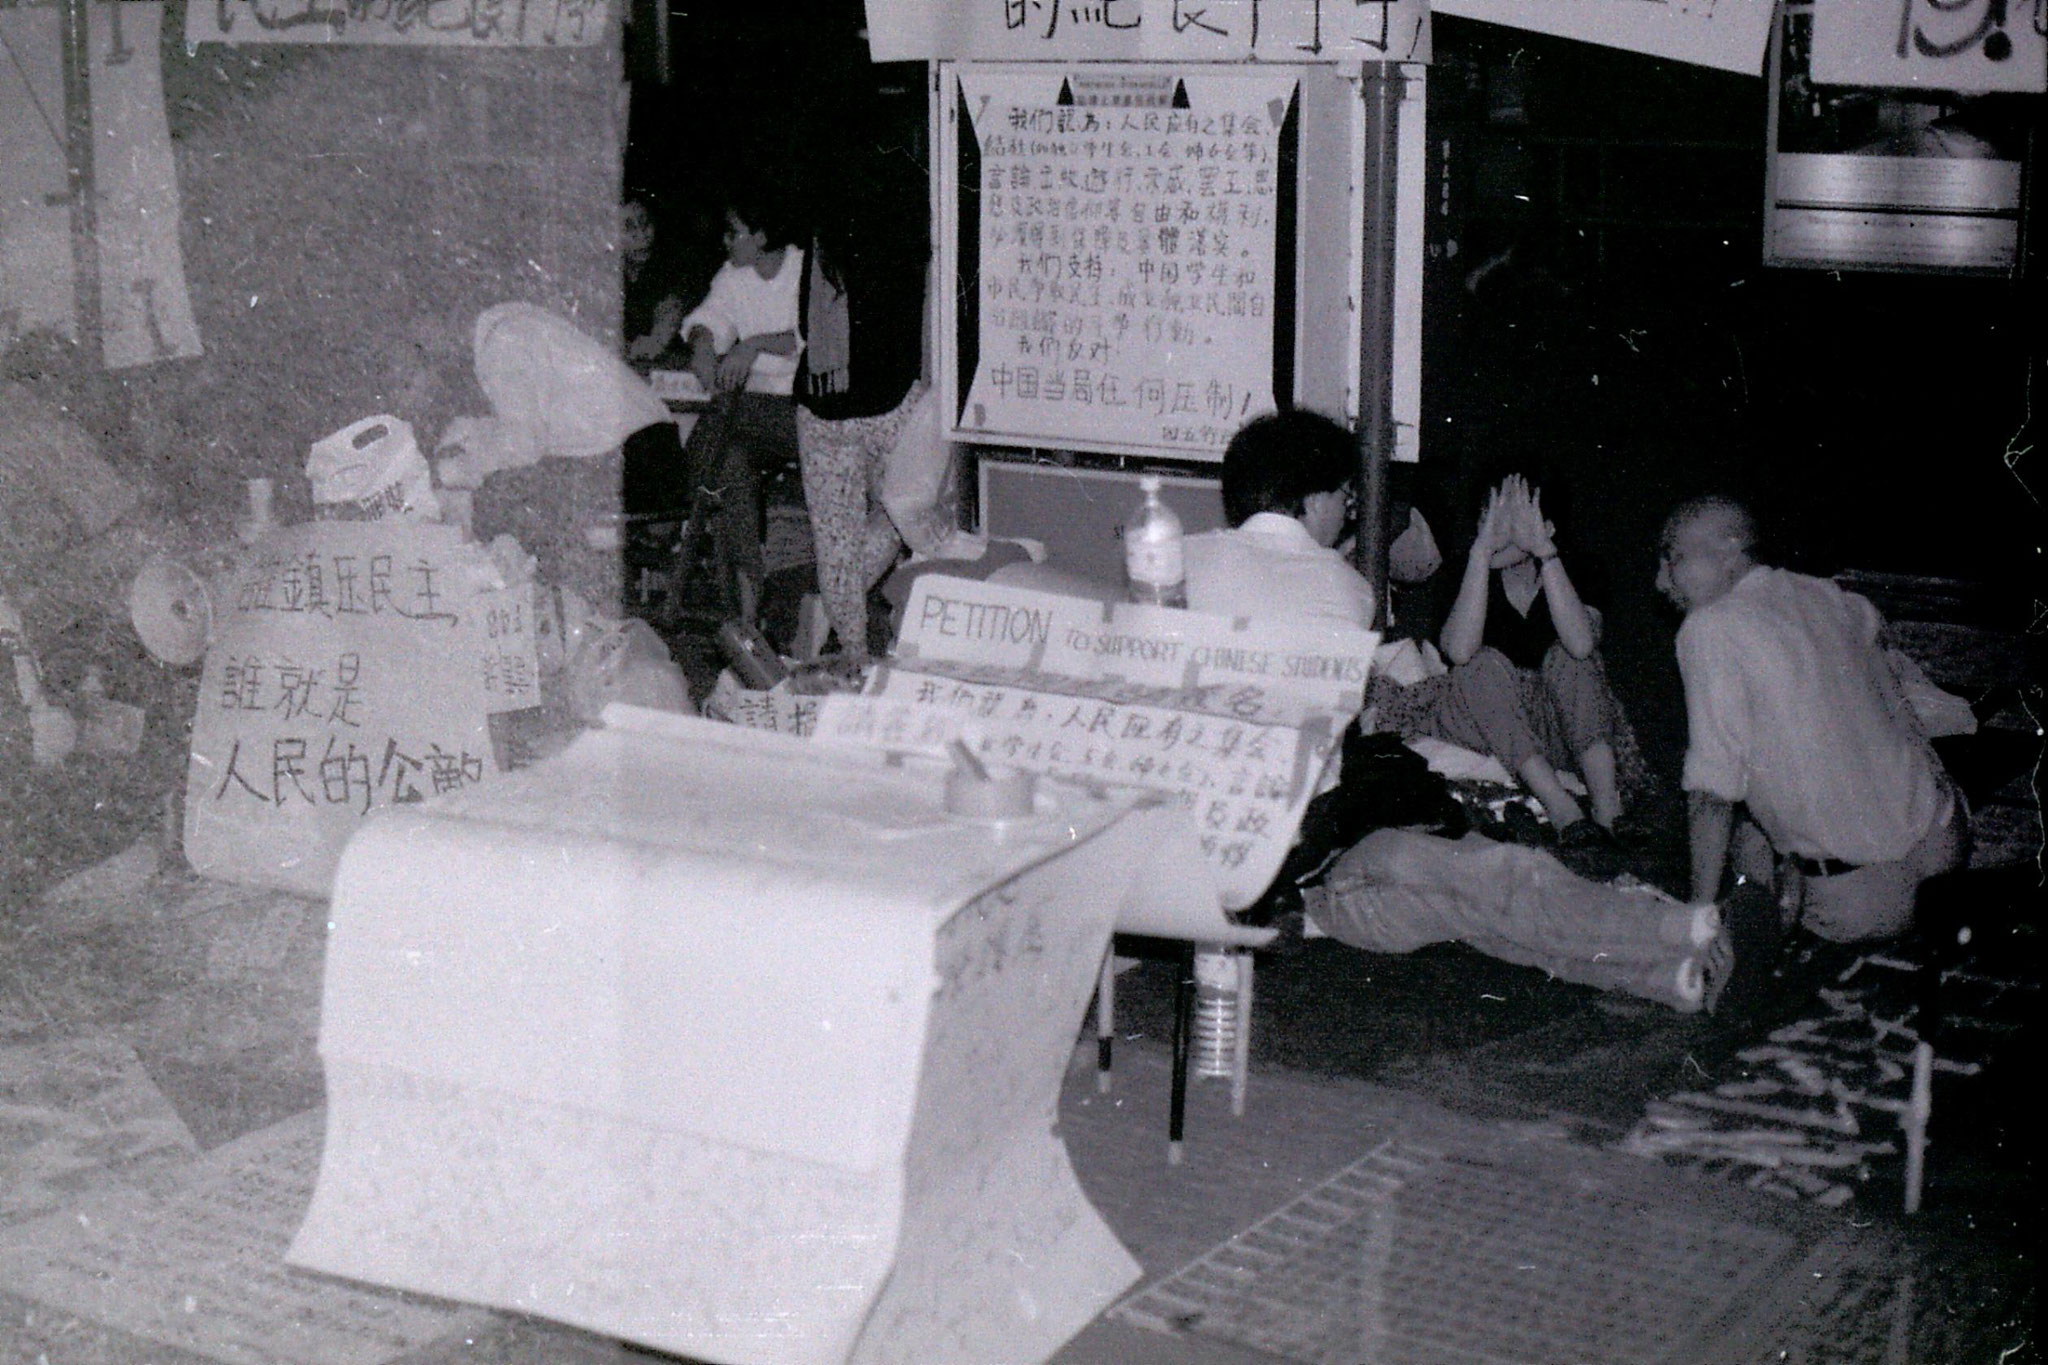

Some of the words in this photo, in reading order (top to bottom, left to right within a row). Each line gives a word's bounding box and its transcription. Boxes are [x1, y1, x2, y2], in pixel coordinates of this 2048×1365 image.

[920, 594, 1053, 643] PETITION
[1065, 628, 1090, 651] TO
[1092, 635, 1185, 662] SUPPORT
